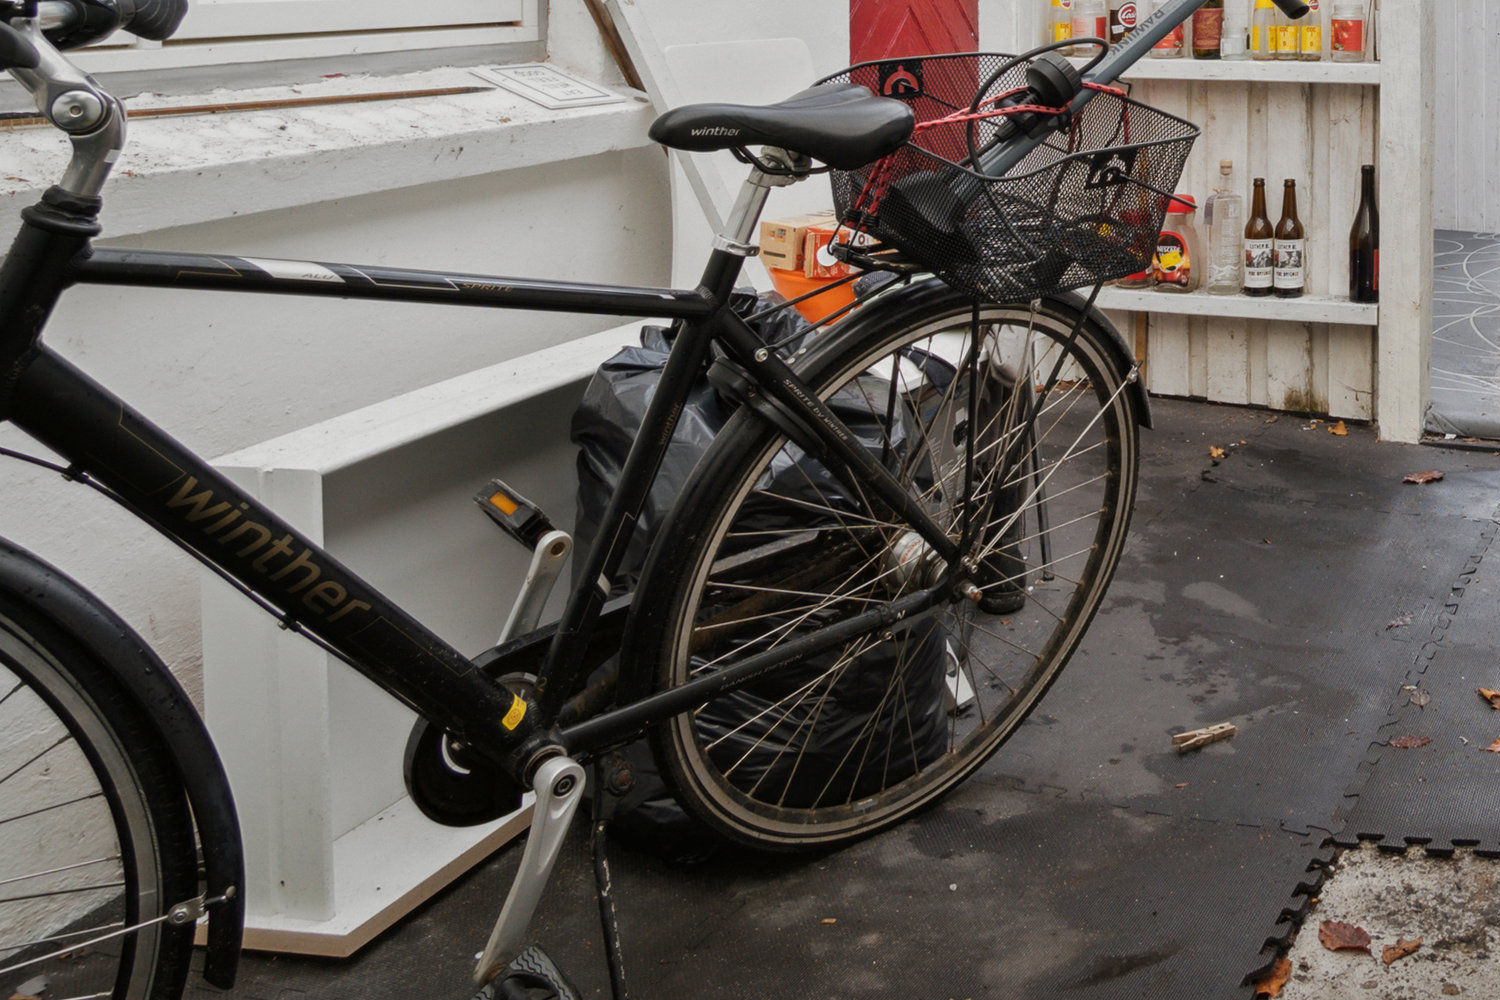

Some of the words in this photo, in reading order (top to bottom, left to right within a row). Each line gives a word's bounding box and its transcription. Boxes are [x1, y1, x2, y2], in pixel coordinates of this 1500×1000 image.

[690, 126, 741, 137] winther
[463, 282, 513, 293] SPRITE
[783, 378, 815, 408] SPRITE
[166, 474, 372, 623] winther
